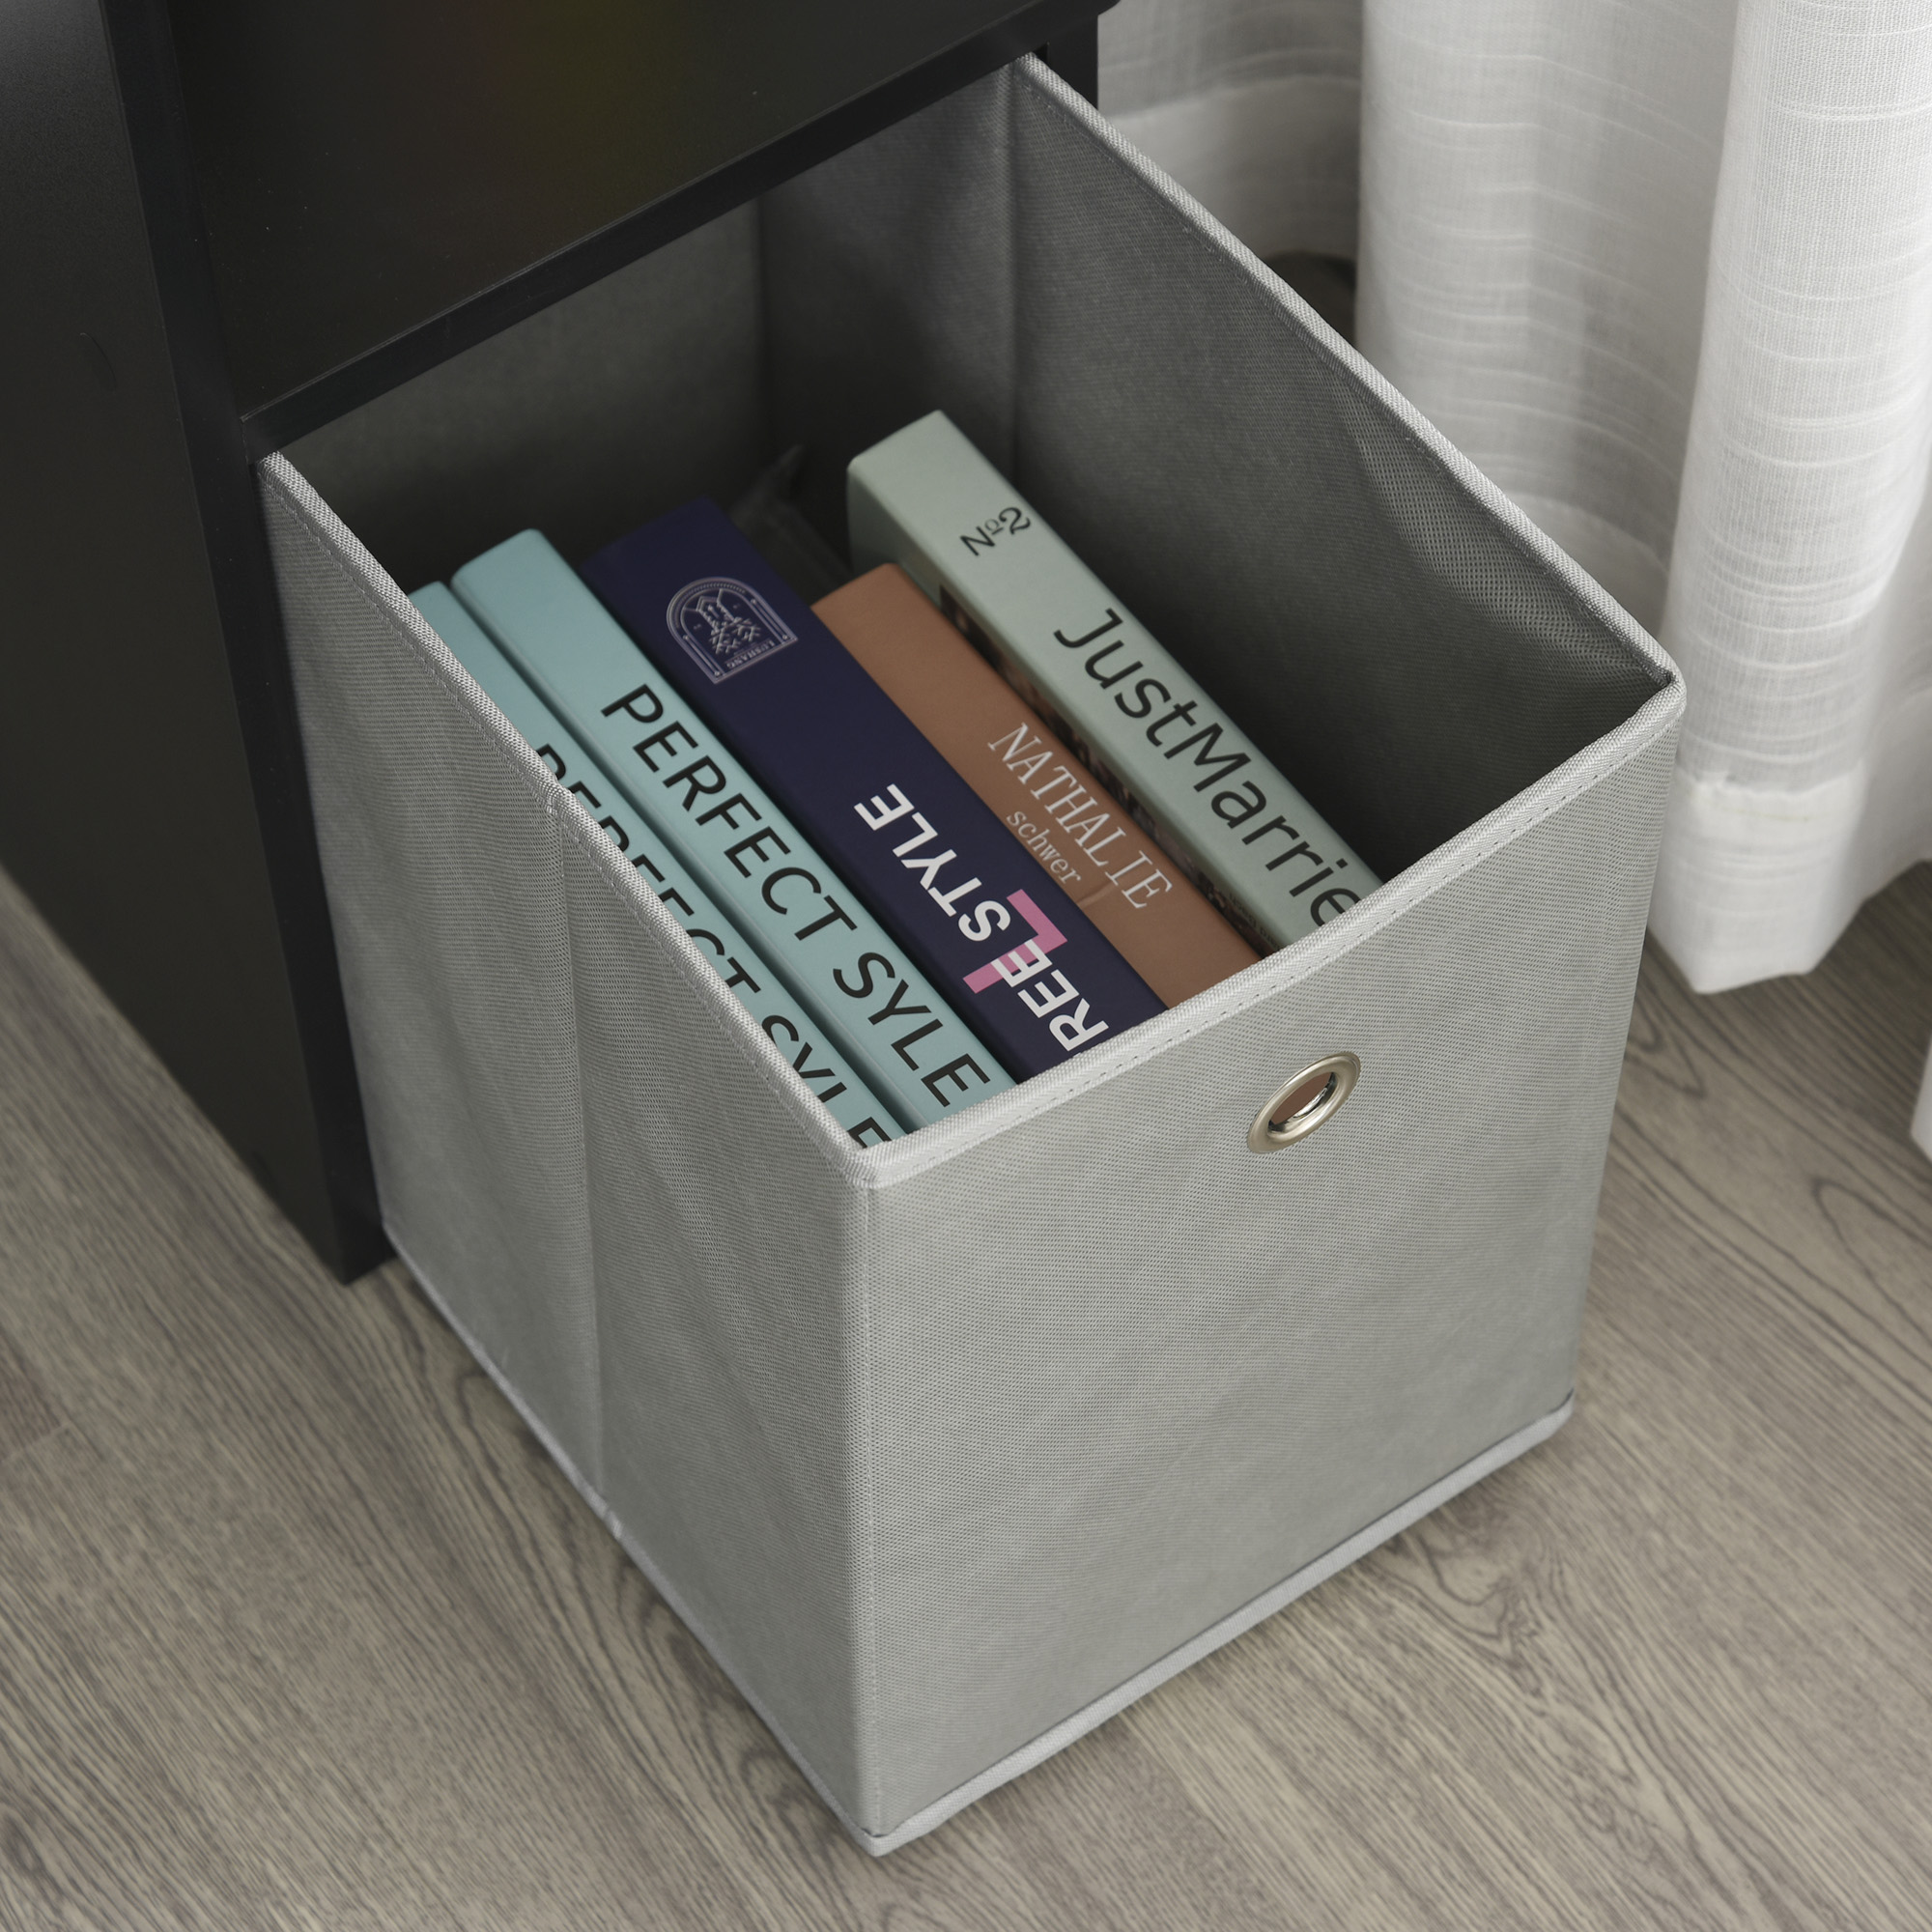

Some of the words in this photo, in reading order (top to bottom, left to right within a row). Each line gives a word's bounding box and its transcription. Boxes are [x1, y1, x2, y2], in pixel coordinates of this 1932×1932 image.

[601, 684, 858, 941] PERFECT
[833, 952, 991, 1108] SYLE
[855, 783, 1011, 942] STYLE
[987, 722, 1173, 909] NATHALIE
[1007, 810, 1082, 884] schwer
